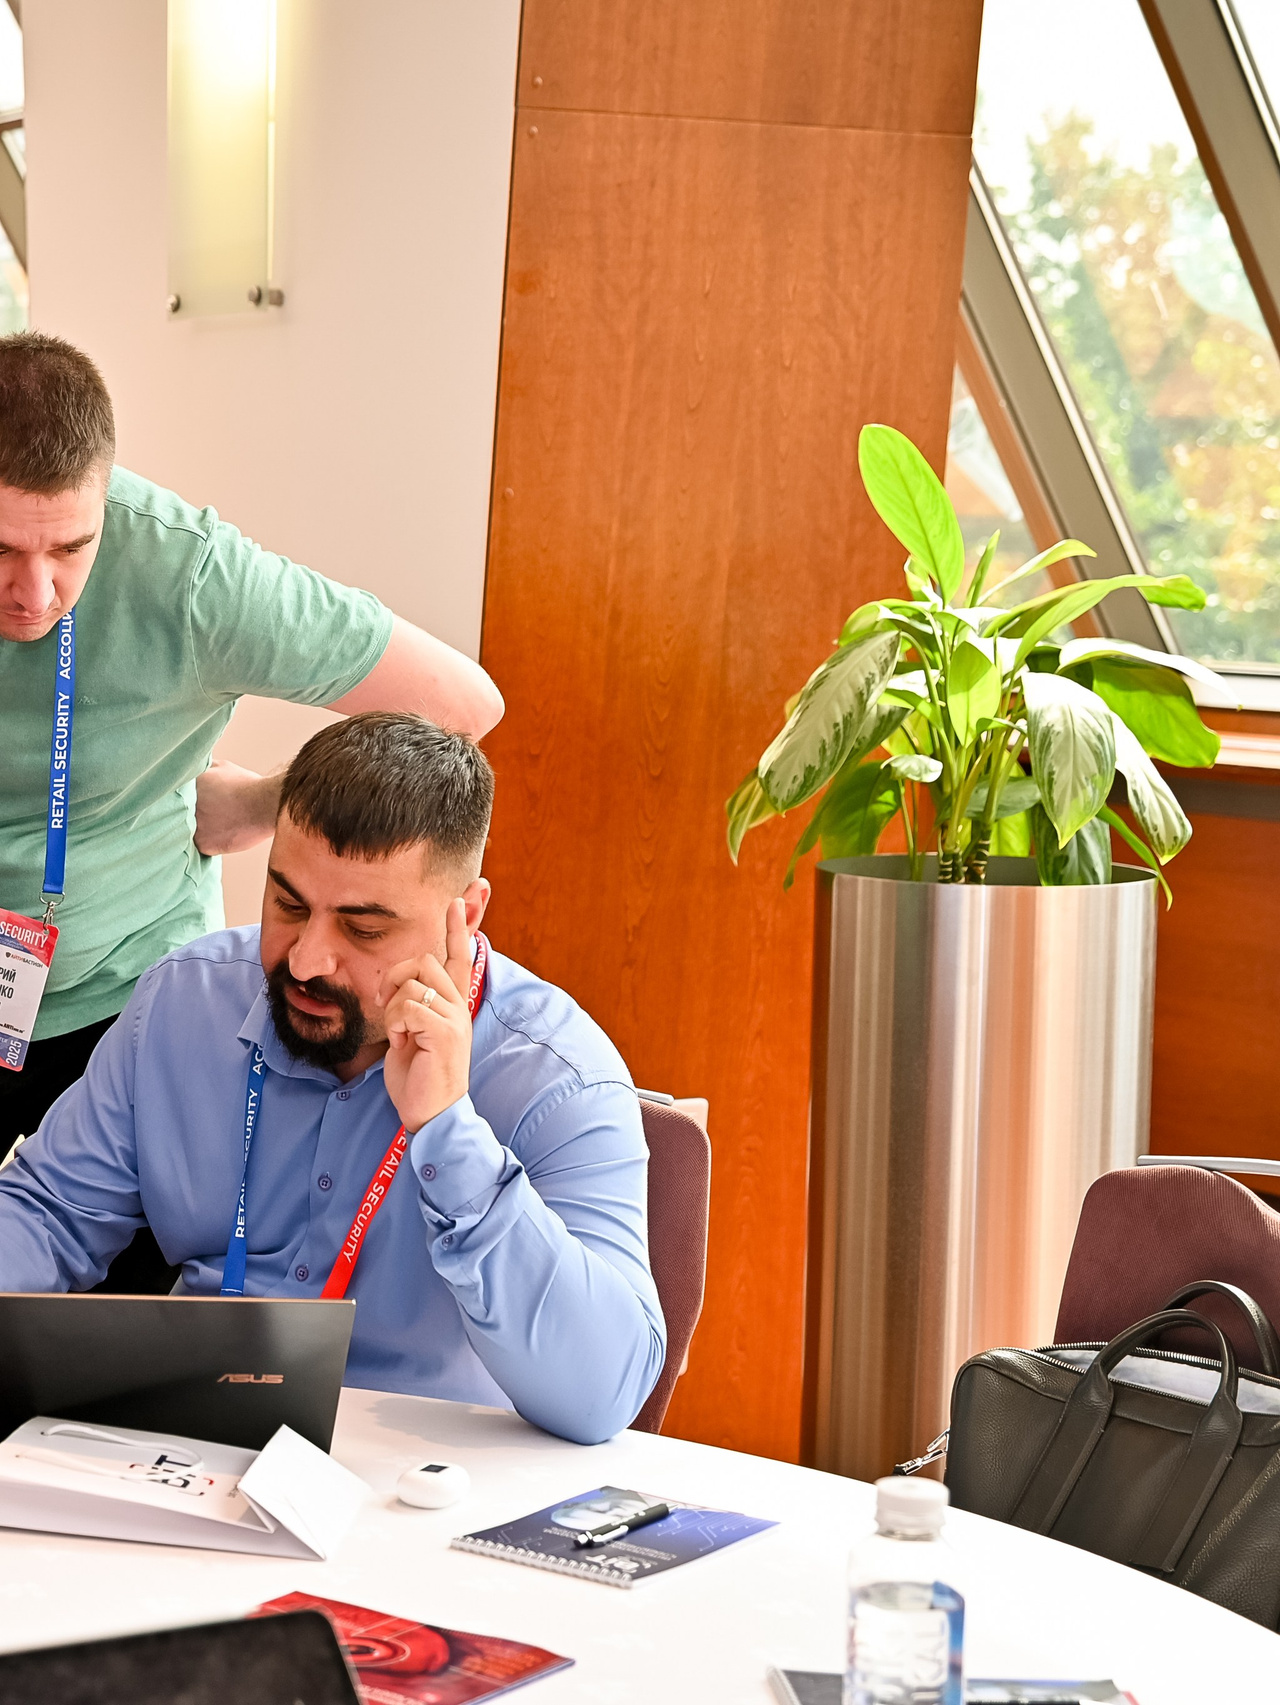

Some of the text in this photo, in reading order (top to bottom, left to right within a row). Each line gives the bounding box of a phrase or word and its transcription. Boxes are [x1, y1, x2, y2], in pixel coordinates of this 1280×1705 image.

[51, 692, 70, 829] RETAIL SECURITY
[5, 1039, 23, 1067] 2025
[234, 1178, 246, 1239] RETAI
[343, 1130, 407, 1264] ETAIL SECURITY
[217, 1373, 284, 1384] ASUS
